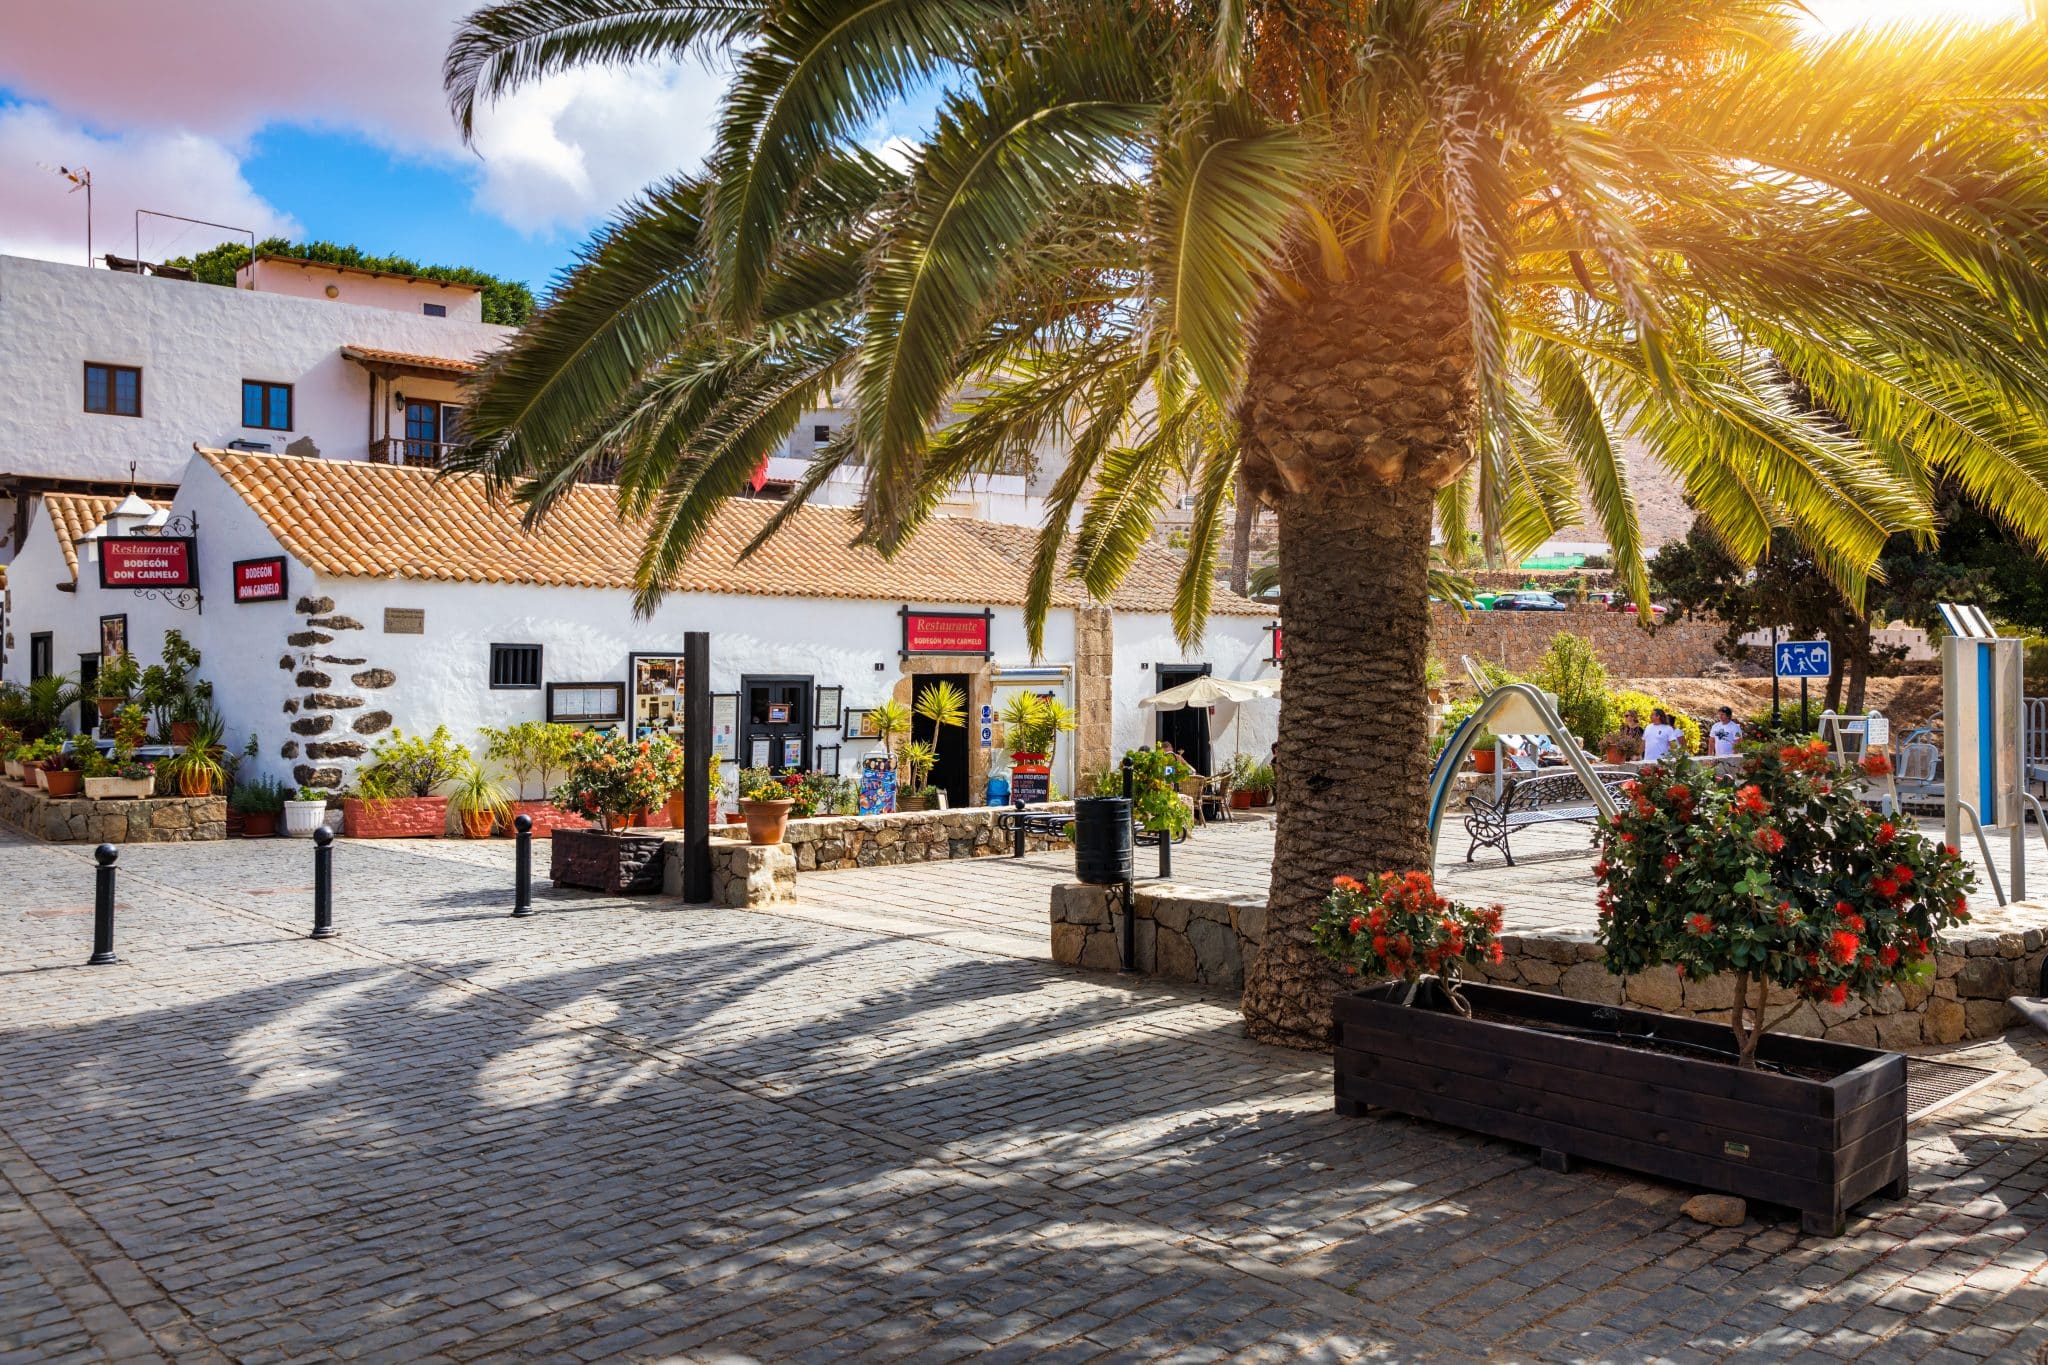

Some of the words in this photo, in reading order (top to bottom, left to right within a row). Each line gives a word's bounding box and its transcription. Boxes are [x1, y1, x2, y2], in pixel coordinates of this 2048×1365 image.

[111, 543, 180, 555] Restaurante
[124, 558, 168, 567] BODEGÓN
[113, 570, 135, 579] DON
[137, 570, 179, 579] CARMELO
[245, 564, 272, 580] BODEGÓN
[239, 585, 253, 598] DON
[253, 582, 280, 597] CARMELO
[917, 619, 978, 633] Restaurante
